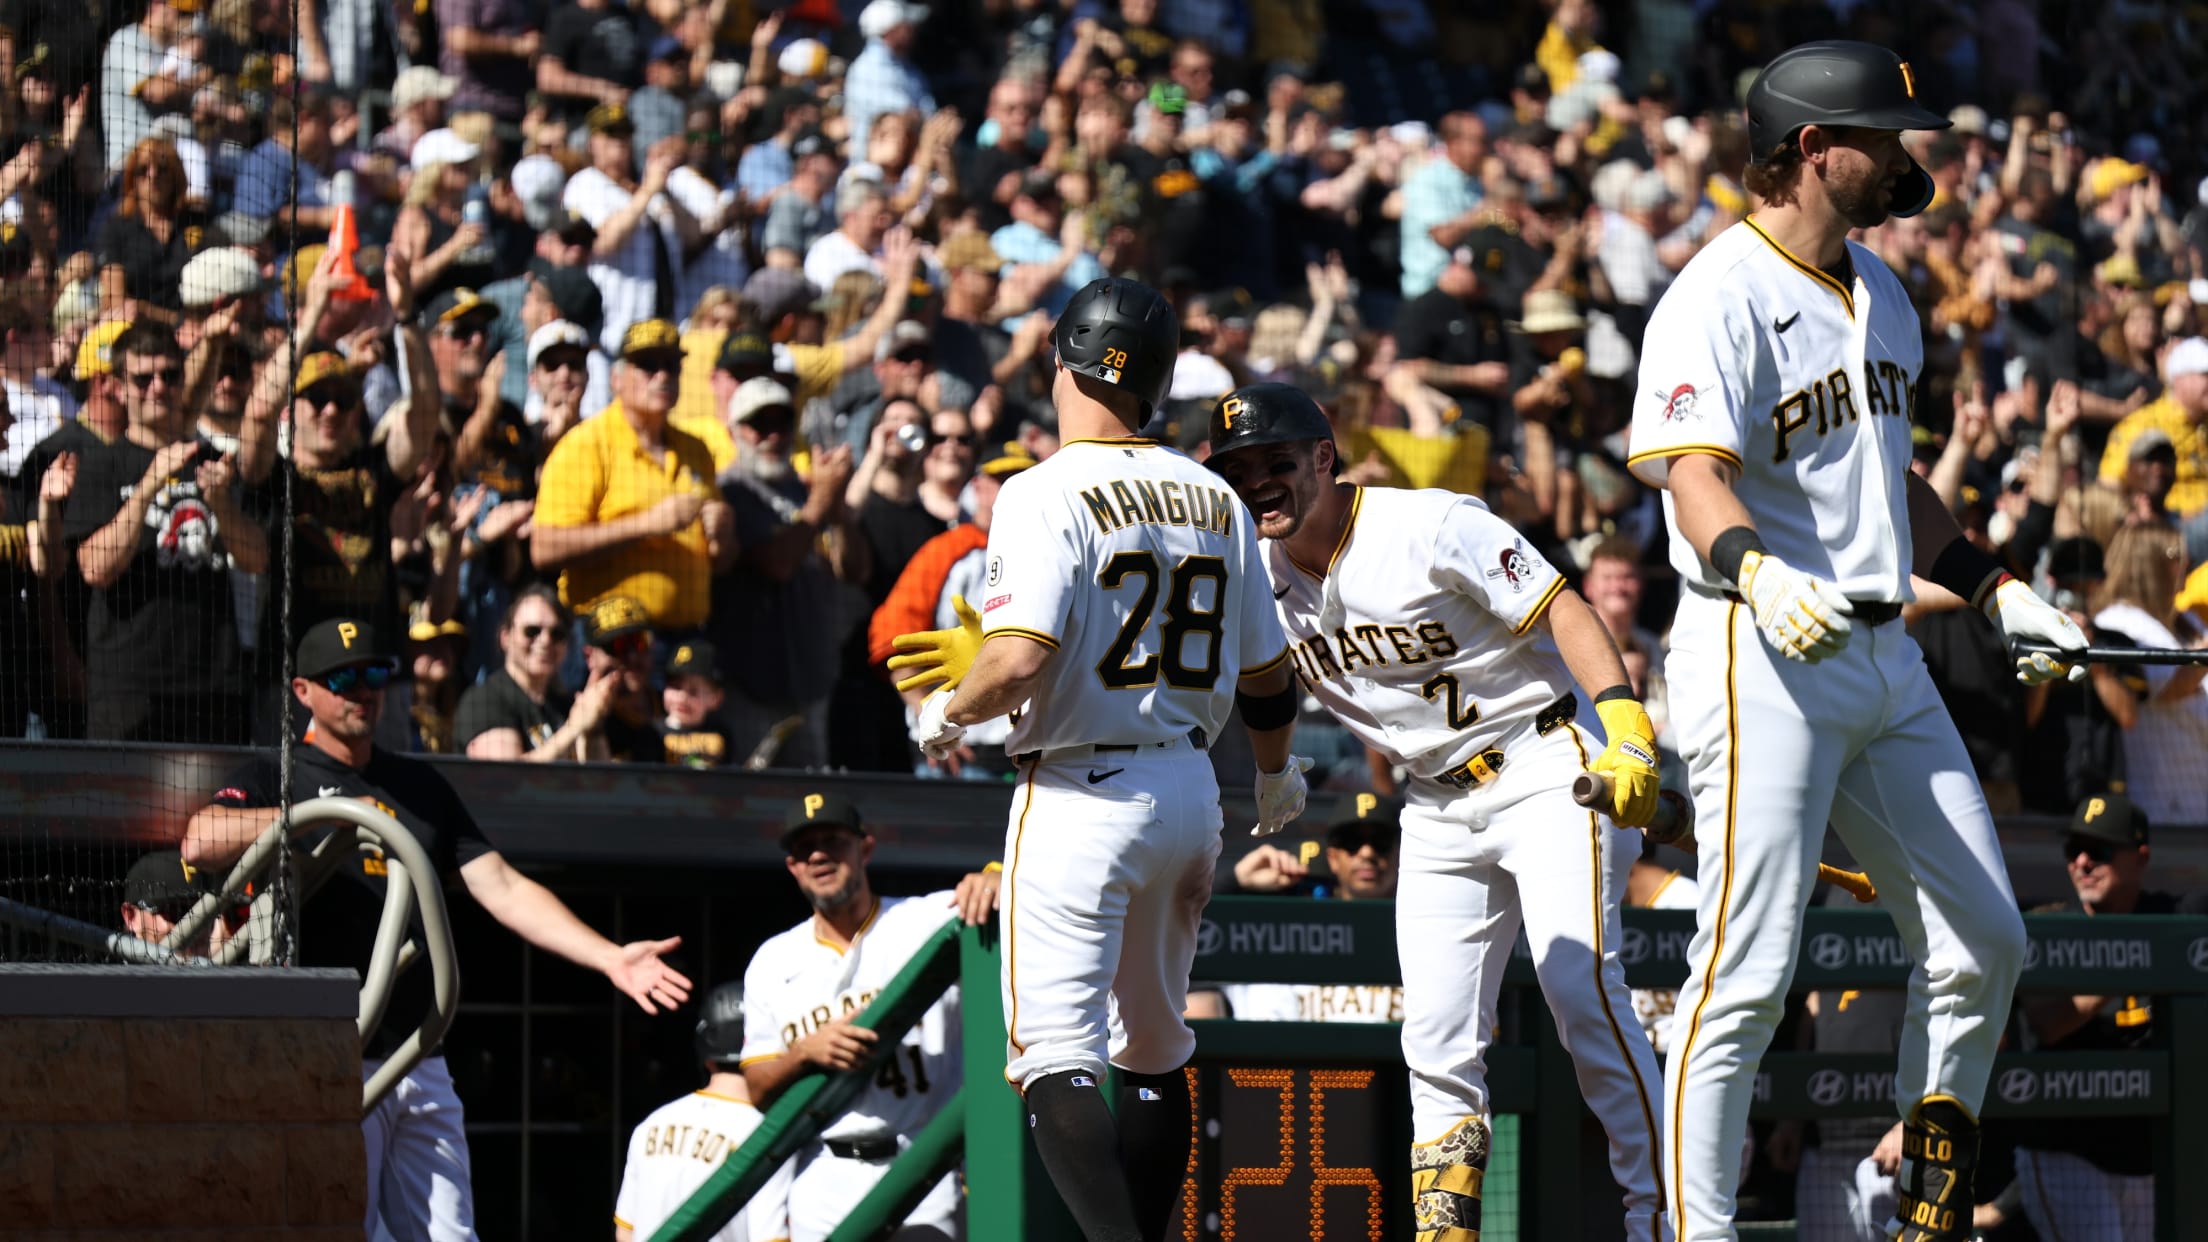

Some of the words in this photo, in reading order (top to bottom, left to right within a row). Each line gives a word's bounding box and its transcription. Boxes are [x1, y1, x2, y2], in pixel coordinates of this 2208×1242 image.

[1103, 347, 1127, 369] 28
[1223, 397, 1242, 430] P
[1079, 479, 1233, 537] MANGUM
[990, 561, 998, 580] 9
[337, 621, 358, 649] P
[1094, 550, 1228, 692] 28
[1420, 671, 1482, 731] 2
[804, 793, 823, 819] P
[1357, 793, 1377, 818] P
[2084, 798, 2106, 824] P
[1301, 841, 1320, 866] P
[1229, 922, 1355, 955] HYUNDAI
[2047, 939, 2152, 969] HYUNDAI
[2044, 1069, 2151, 1099] HYUNDAI
[645, 1124, 692, 1156] BAT
[1937, 1168, 1958, 1204] 7
